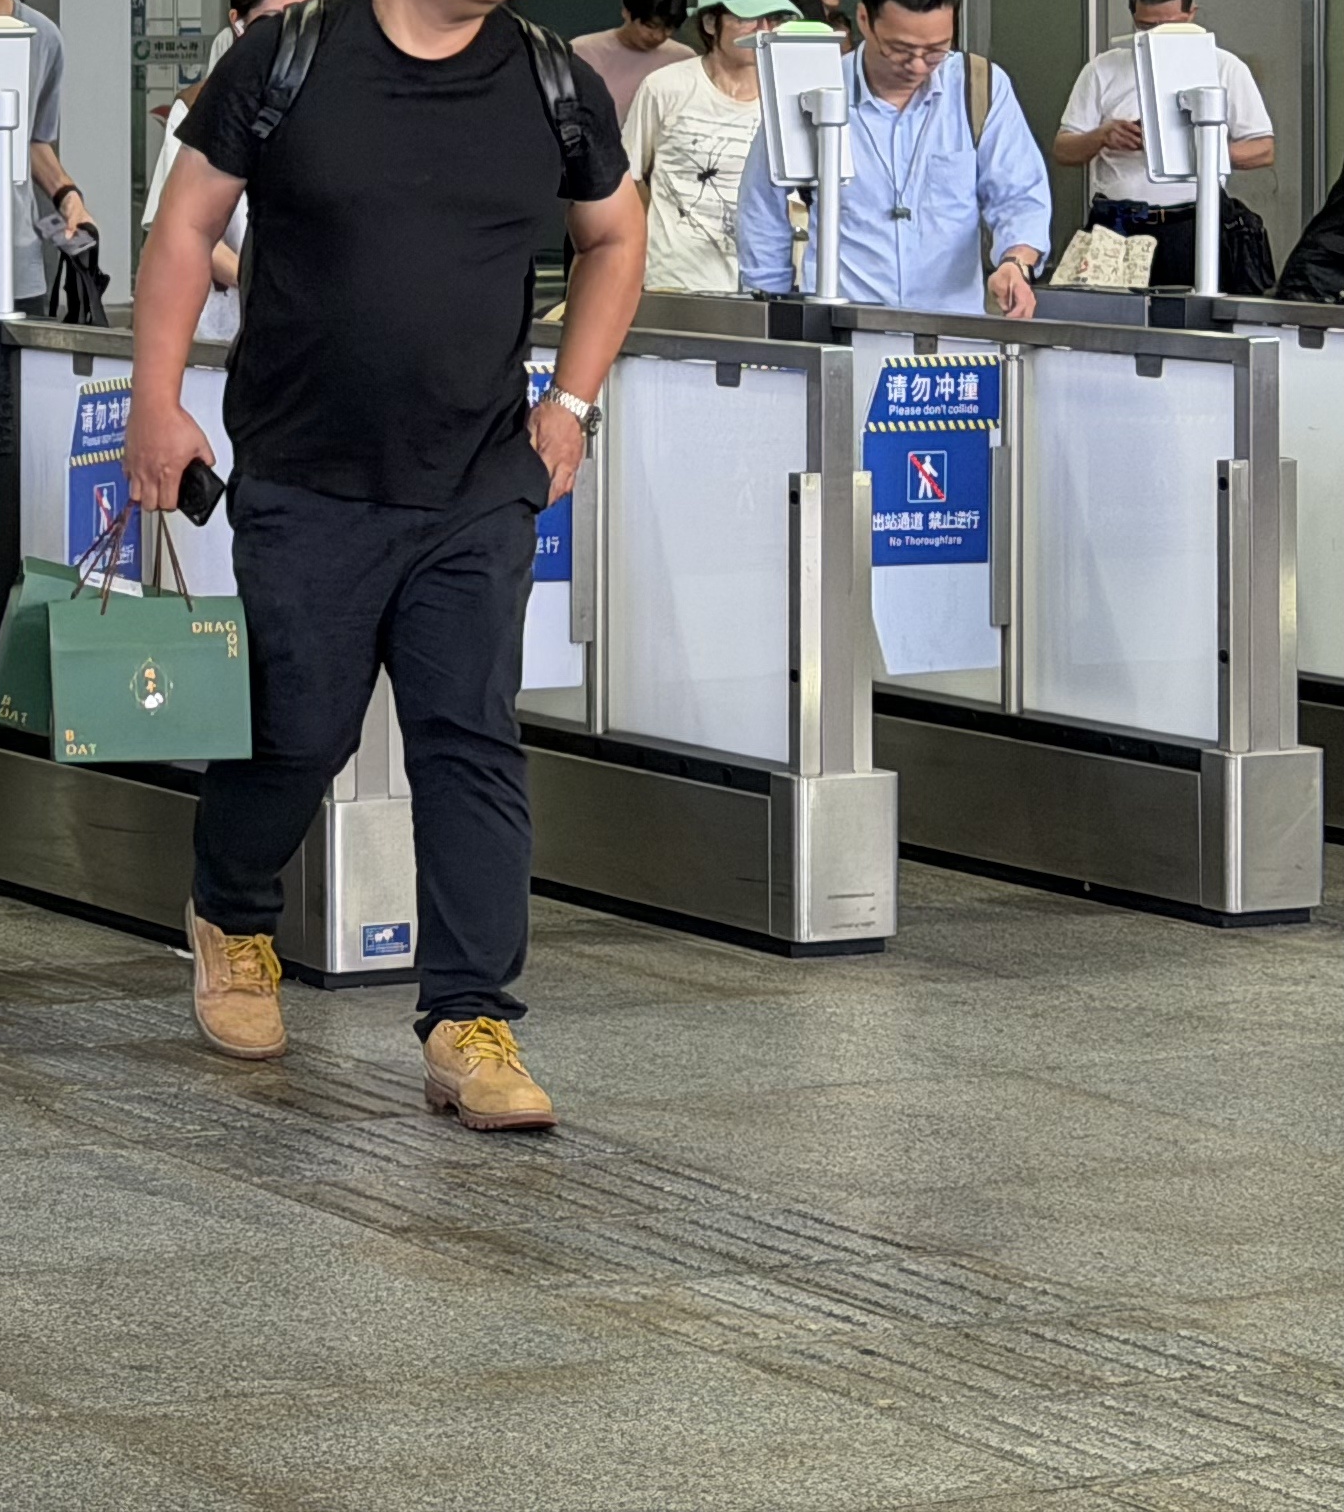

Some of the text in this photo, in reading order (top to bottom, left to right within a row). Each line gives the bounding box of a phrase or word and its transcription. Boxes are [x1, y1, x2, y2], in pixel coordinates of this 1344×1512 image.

[886, 372, 978, 402] 请勿冲撞
[889, 405, 921, 415] Please
